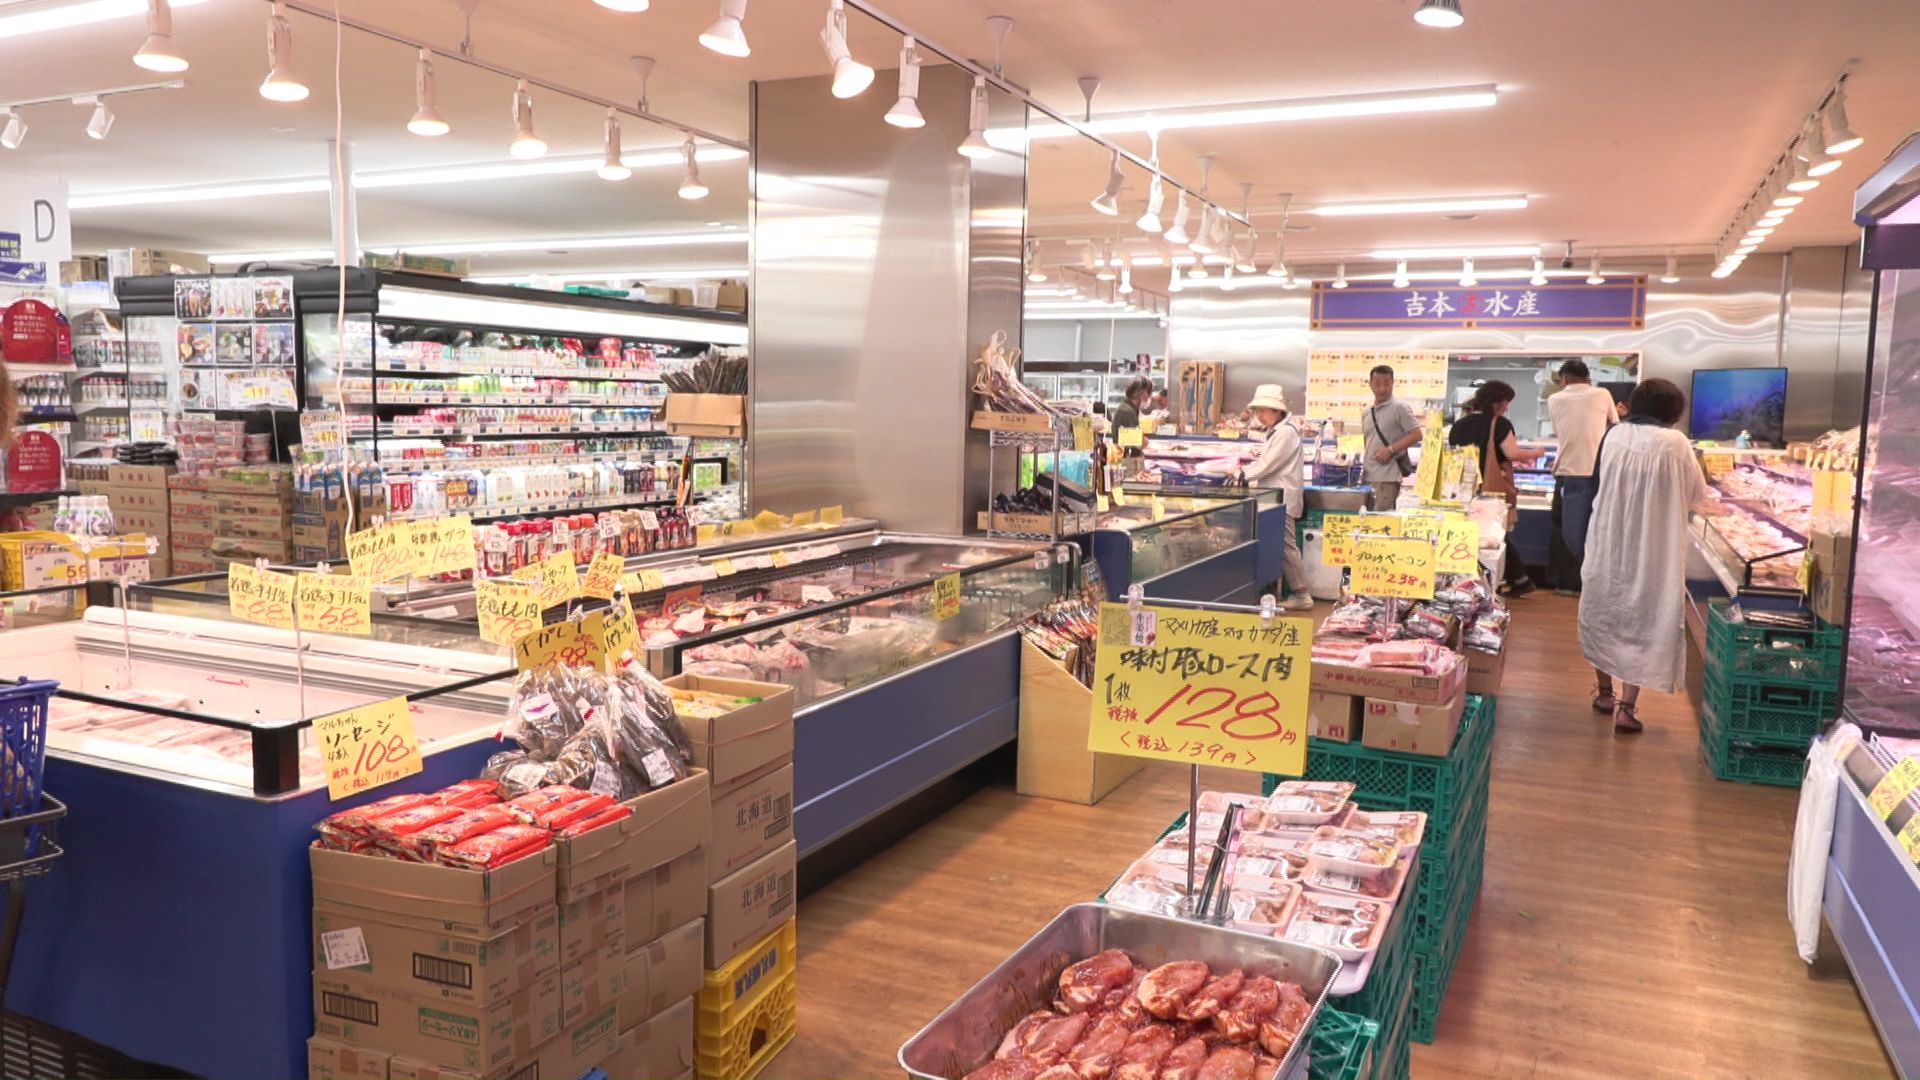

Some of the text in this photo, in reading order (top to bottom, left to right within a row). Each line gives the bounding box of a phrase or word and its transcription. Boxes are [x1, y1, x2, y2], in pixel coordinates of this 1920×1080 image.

[33, 199, 56, 243] D
[1403, 290, 1541, 318] 吉本 水産
[735, 793, 773, 829] 北海道
[742, 872, 777, 910] 北海道
